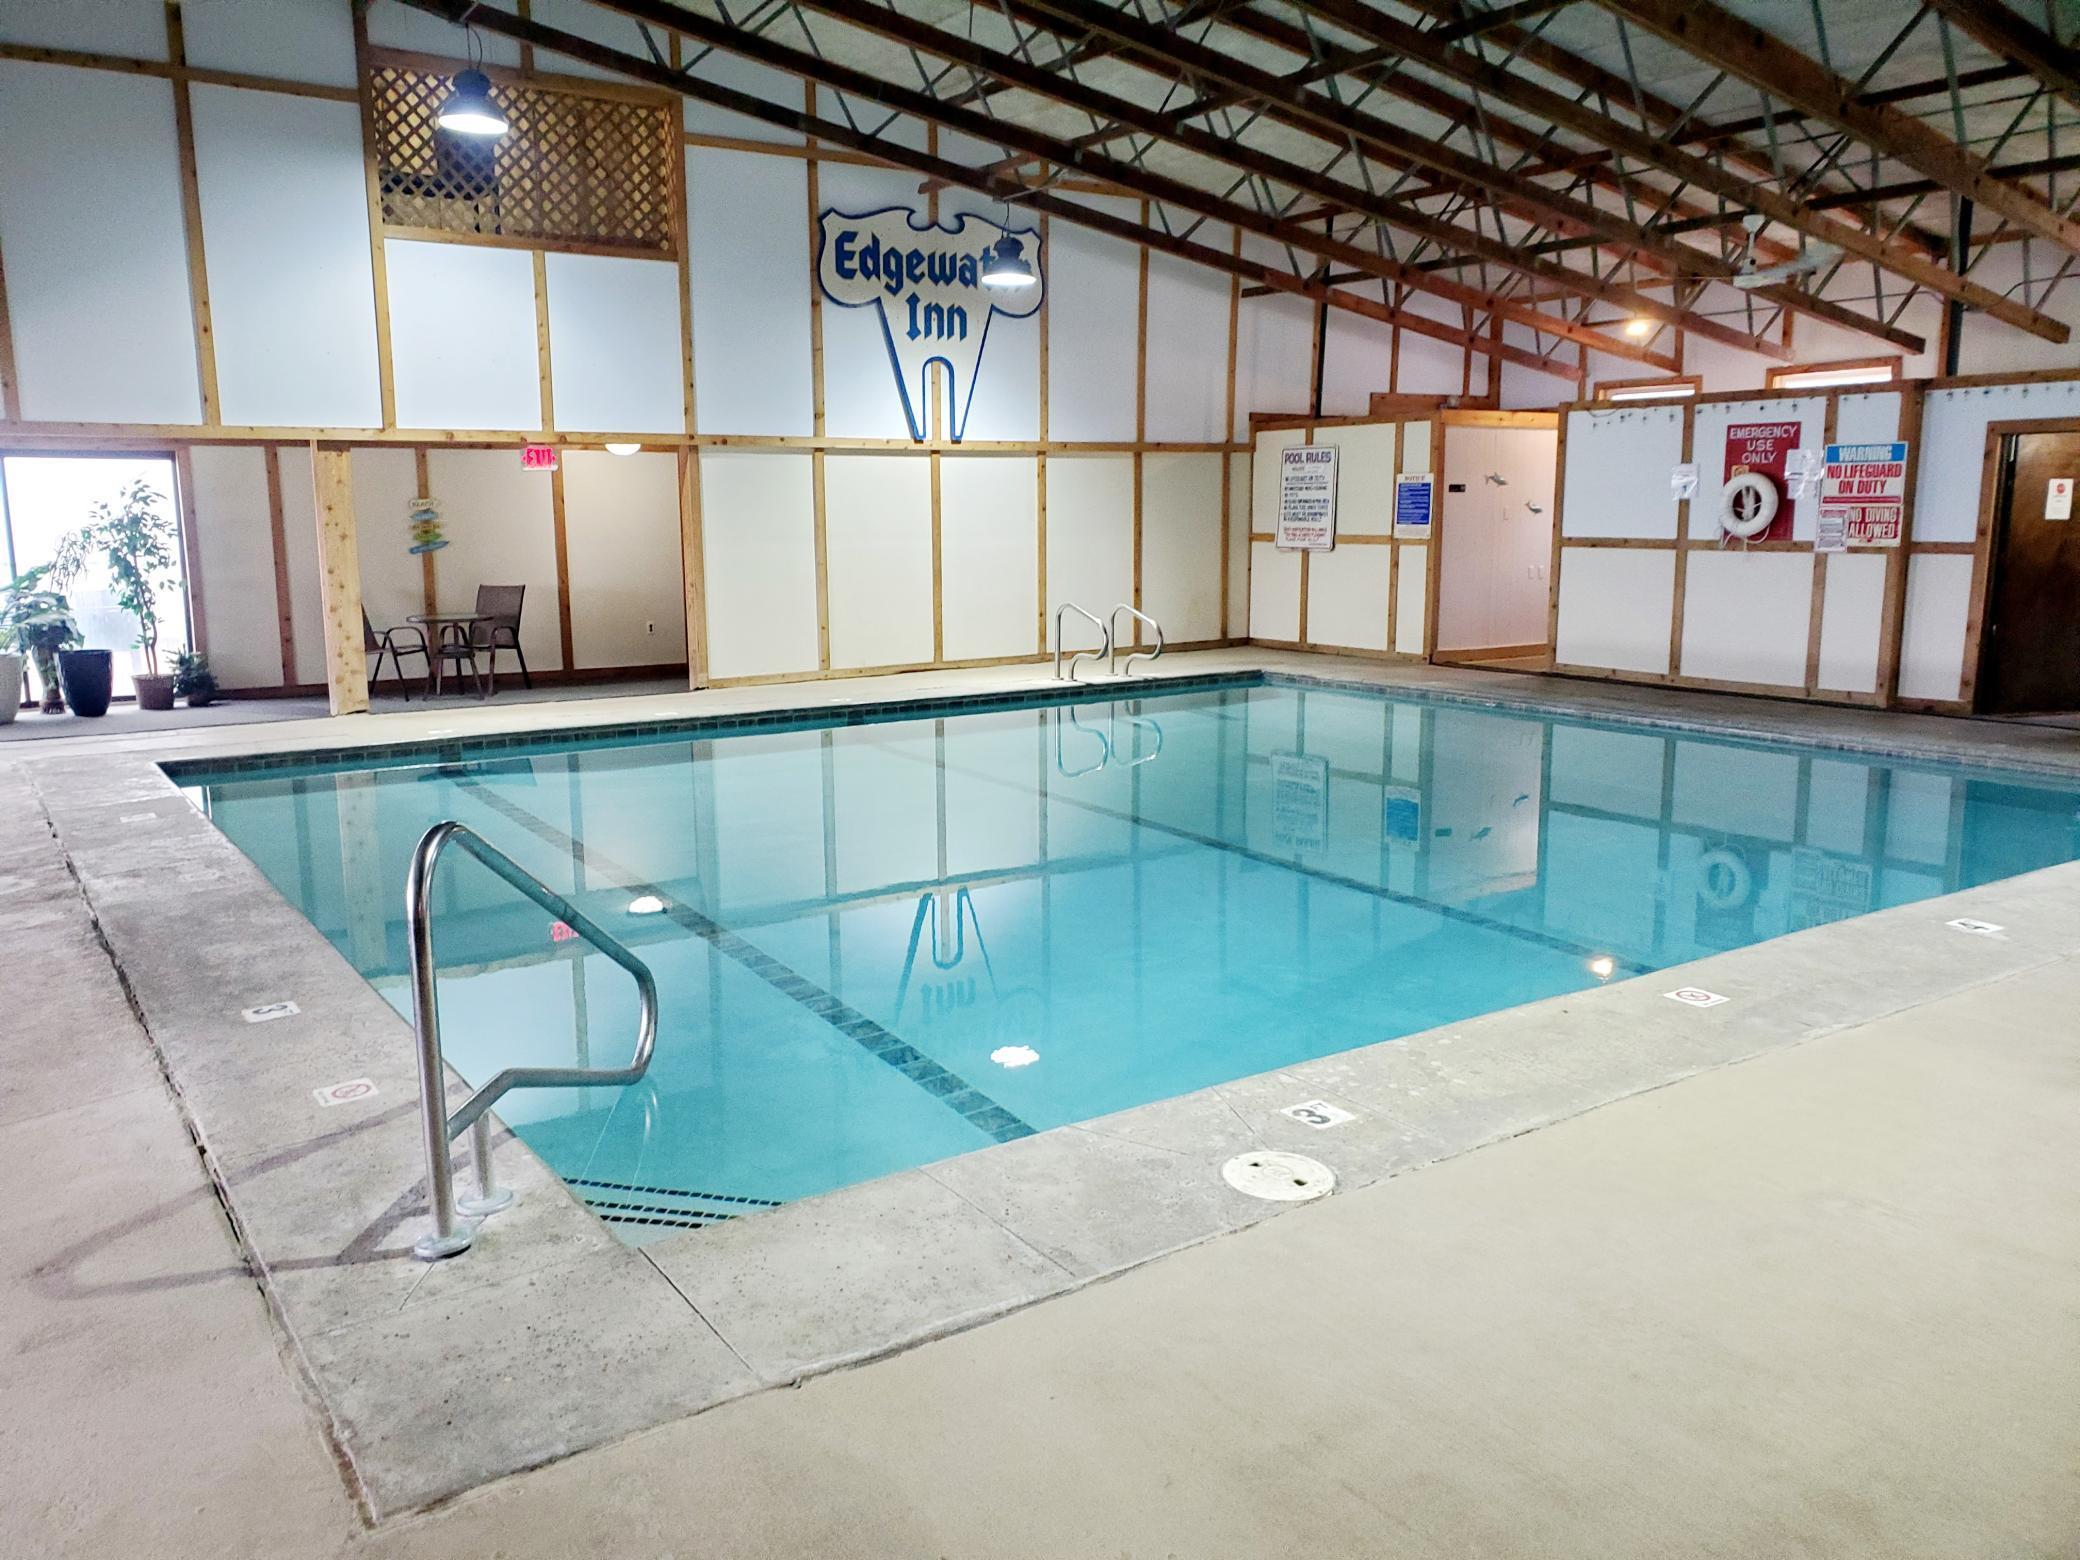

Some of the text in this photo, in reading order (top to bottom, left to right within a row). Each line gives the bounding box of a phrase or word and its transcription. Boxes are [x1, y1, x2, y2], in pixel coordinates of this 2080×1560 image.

[835, 231, 1012, 297] Edgewat
[906, 292, 967, 341] Inn
[1730, 426, 1797, 439] EMERGENCY
[1747, 440, 1775, 451] USE
[527, 448, 552, 465] EXIT
[1285, 451, 1331, 464] POOL RULES
[1741, 453, 1776, 464] ONLY
[1839, 446, 1892, 462] WARNING
[1827, 463, 1902, 478] NO LIFEGUARD
[1839, 480, 1886, 493] ON DUTY
[1848, 507, 1897, 522] NO DIVING
[1849, 523, 1895, 538] ALLOWED
[1292, 1108, 1331, 1124] 3
